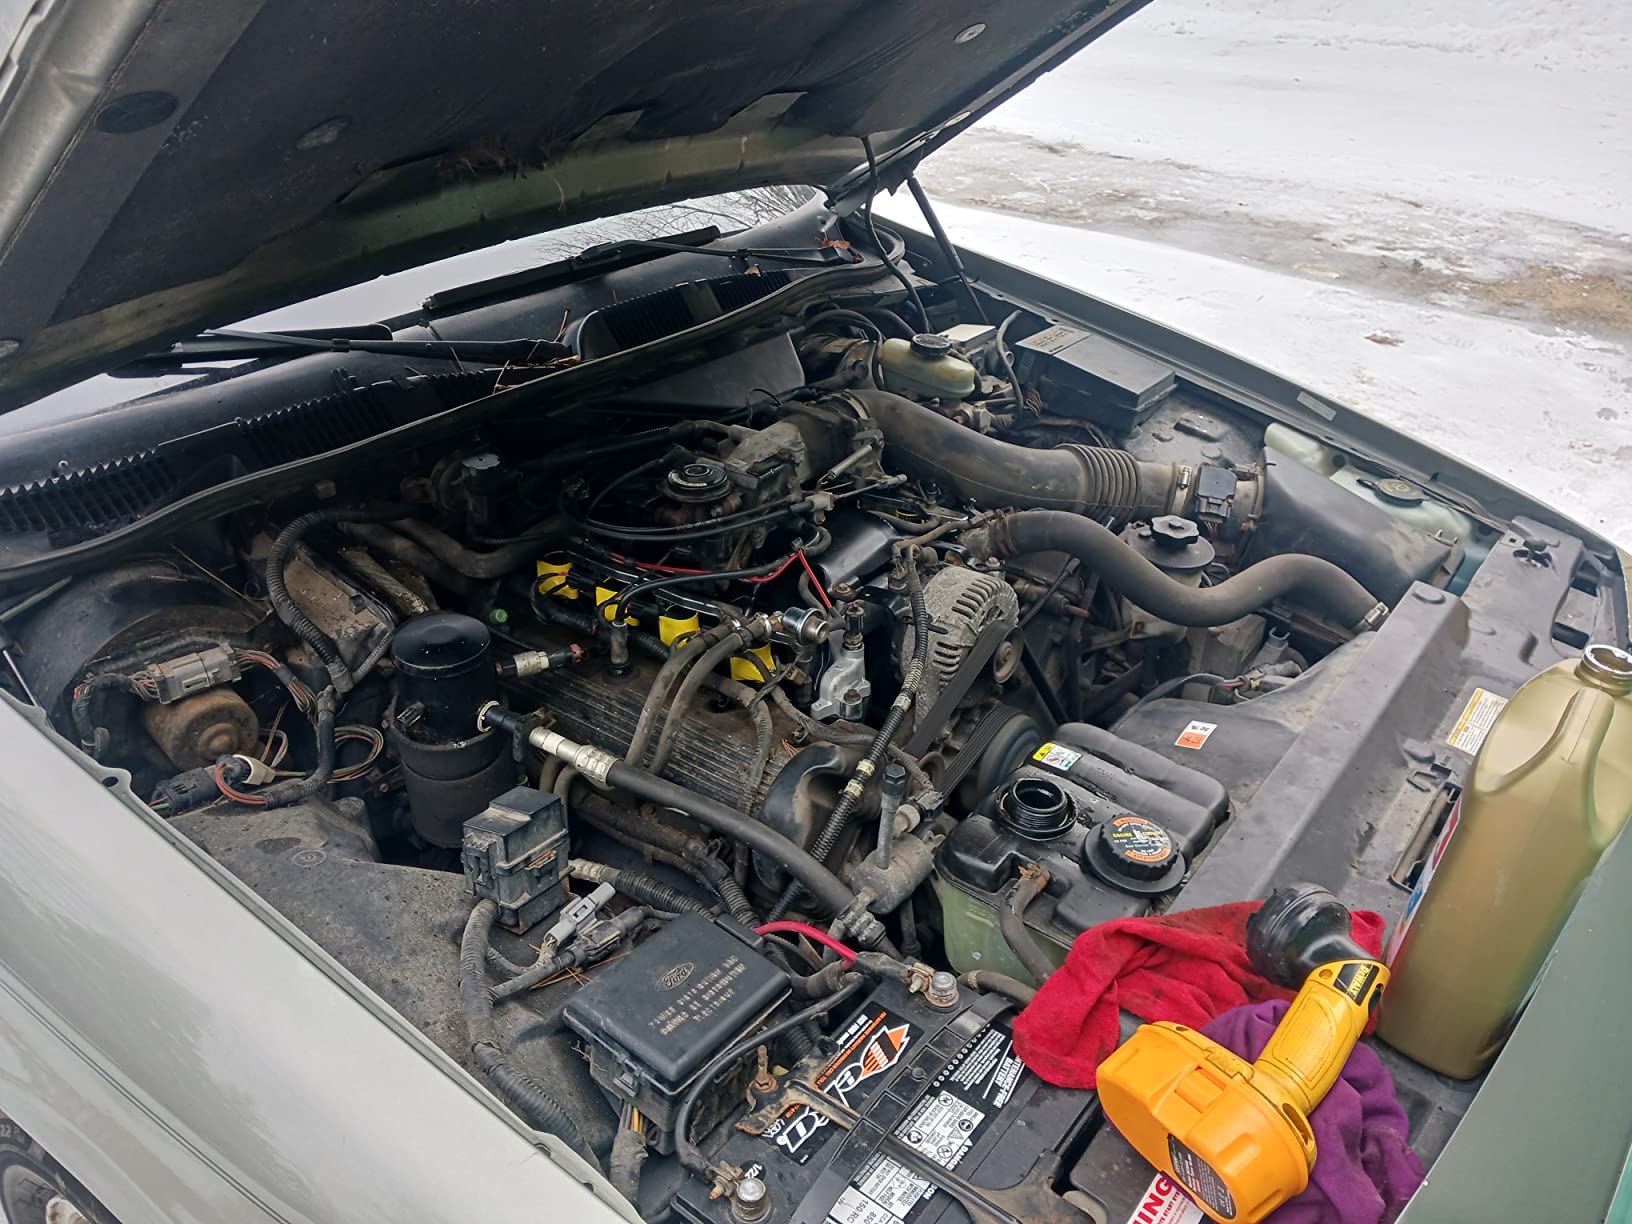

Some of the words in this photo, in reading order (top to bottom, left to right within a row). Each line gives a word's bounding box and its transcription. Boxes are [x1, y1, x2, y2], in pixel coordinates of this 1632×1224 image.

[663, 965, 689, 987] Ford
[1348, 964, 1370, 996] DEWALT
[995, 1058, 1013, 1087] BATTERY
[992, 1055, 1022, 1108] NTENANCE-FREE
[745, 1163, 763, 1180] 1/22
[855, 1199, 869, 1214] 150
[1162, 1200, 1175, 1217] START
[846, 1212, 860, 1224] RC
[864, 1211, 877, 1224] 850
[877, 1213, 888, 1224] CCA
